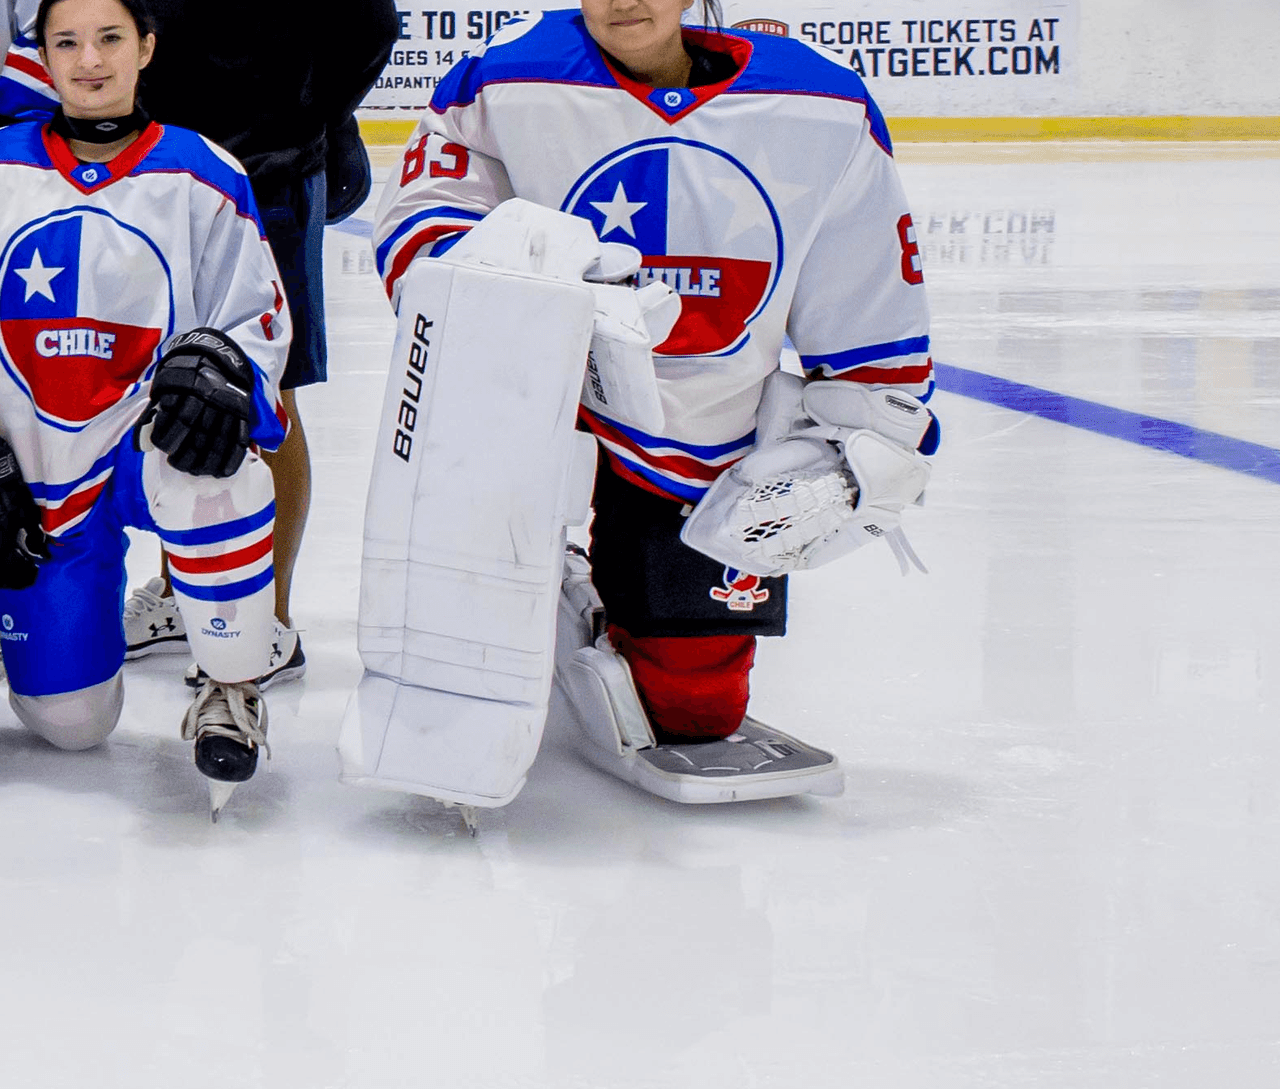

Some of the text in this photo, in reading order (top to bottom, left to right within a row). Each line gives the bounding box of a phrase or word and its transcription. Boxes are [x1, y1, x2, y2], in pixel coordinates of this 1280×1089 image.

[801, 18, 1059, 45] SCORE TICKETS AT
[435, 50, 454, 65] 14
[35, 327, 117, 361] CHILE
[393, 312, 434, 463] BAUER
[201, 628, 241, 640] DYNASTY
